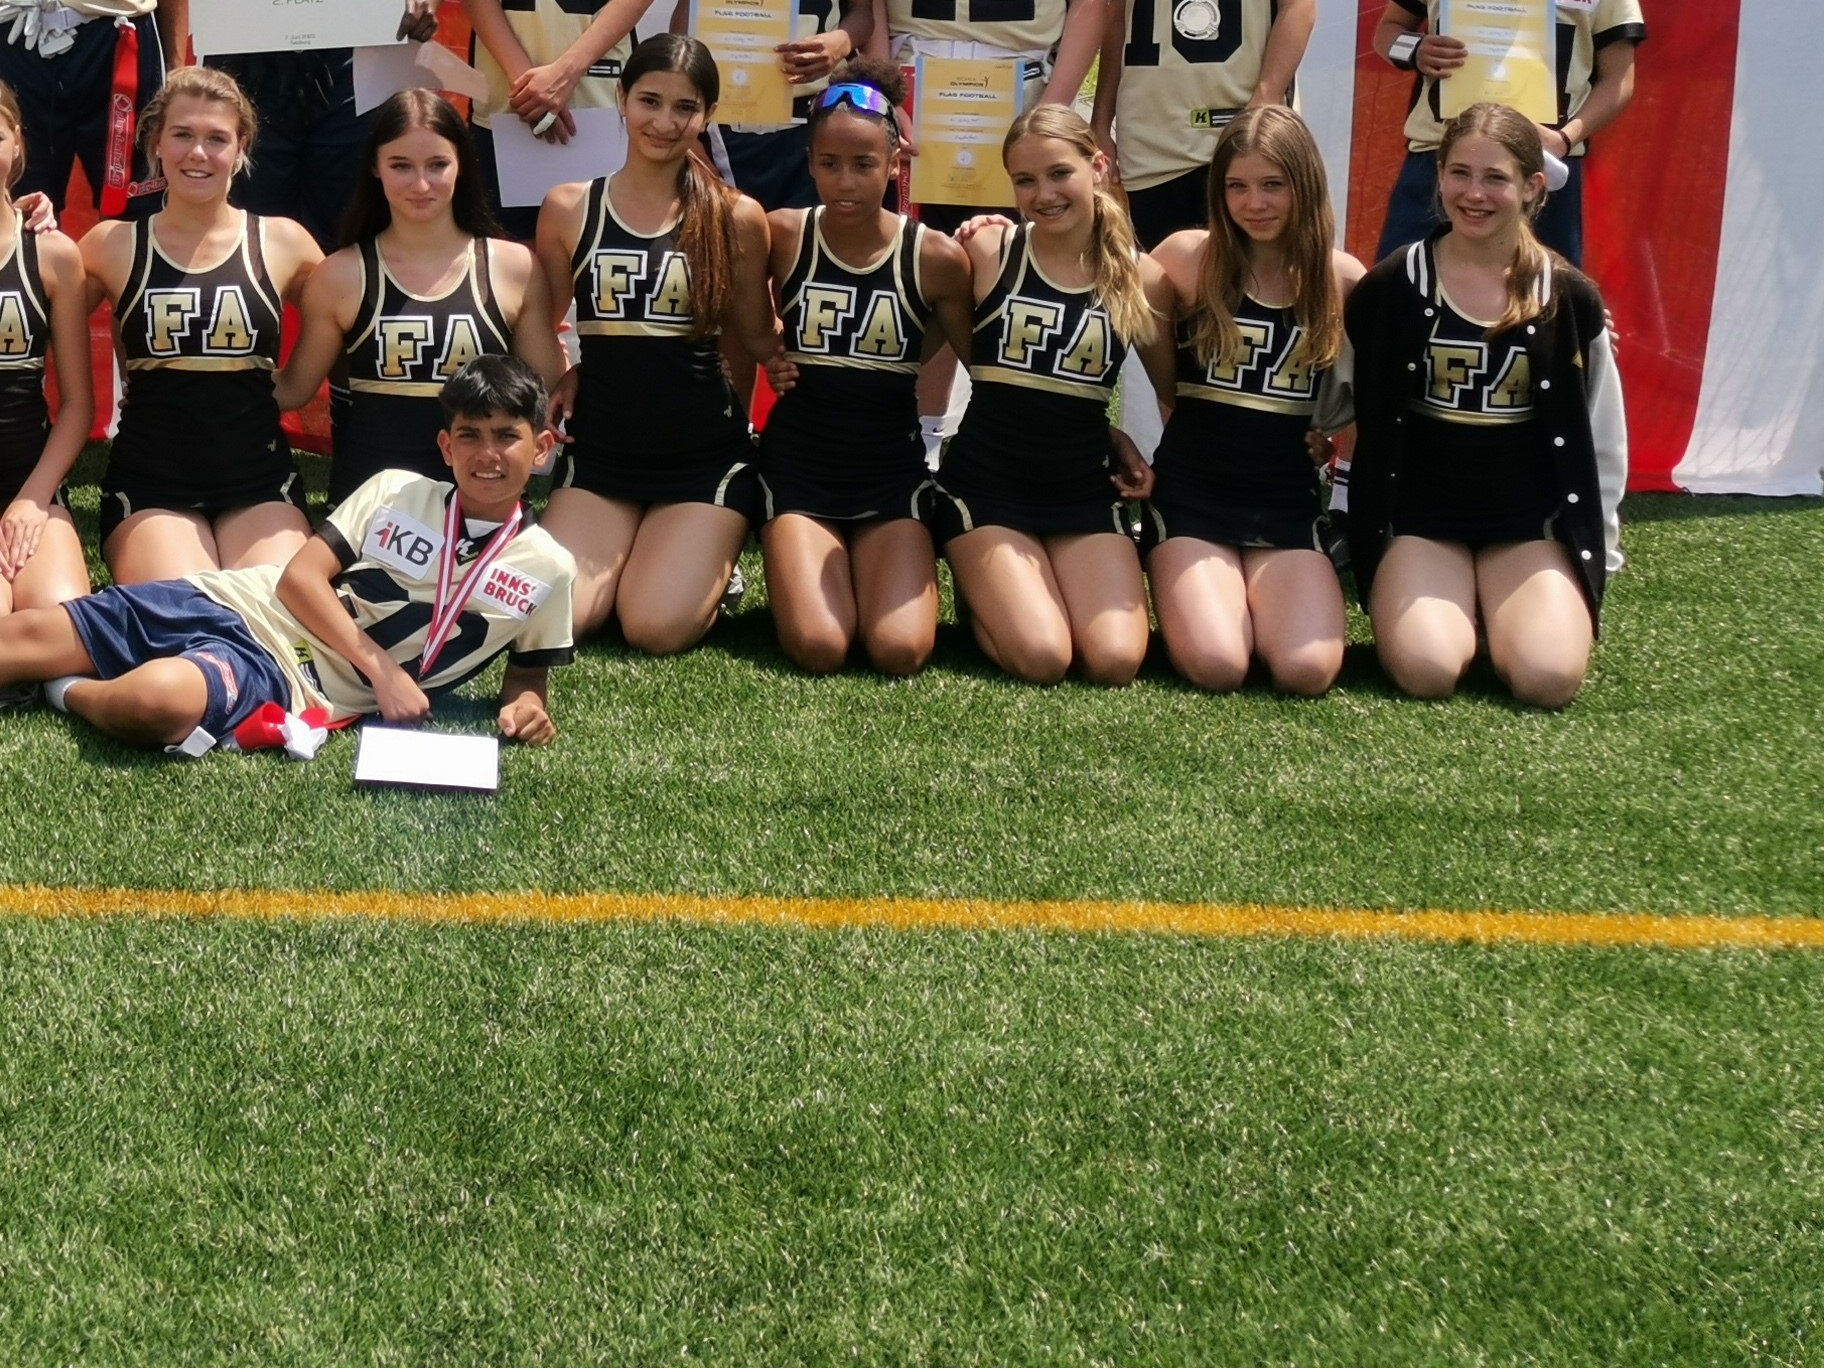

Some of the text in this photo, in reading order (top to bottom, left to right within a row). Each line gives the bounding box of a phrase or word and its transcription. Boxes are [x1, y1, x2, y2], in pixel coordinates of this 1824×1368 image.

[144, 285, 258, 356] FA
[590, 249, 693, 322] FA
[797, 281, 909, 361] FA
[376, 314, 486, 381] FA
[997, 294, 1113, 381] FA
[1206, 317, 1318, 399] FA
[1423, 337, 1535, 413] FA
[483, 580, 538, 617] BRUCK
